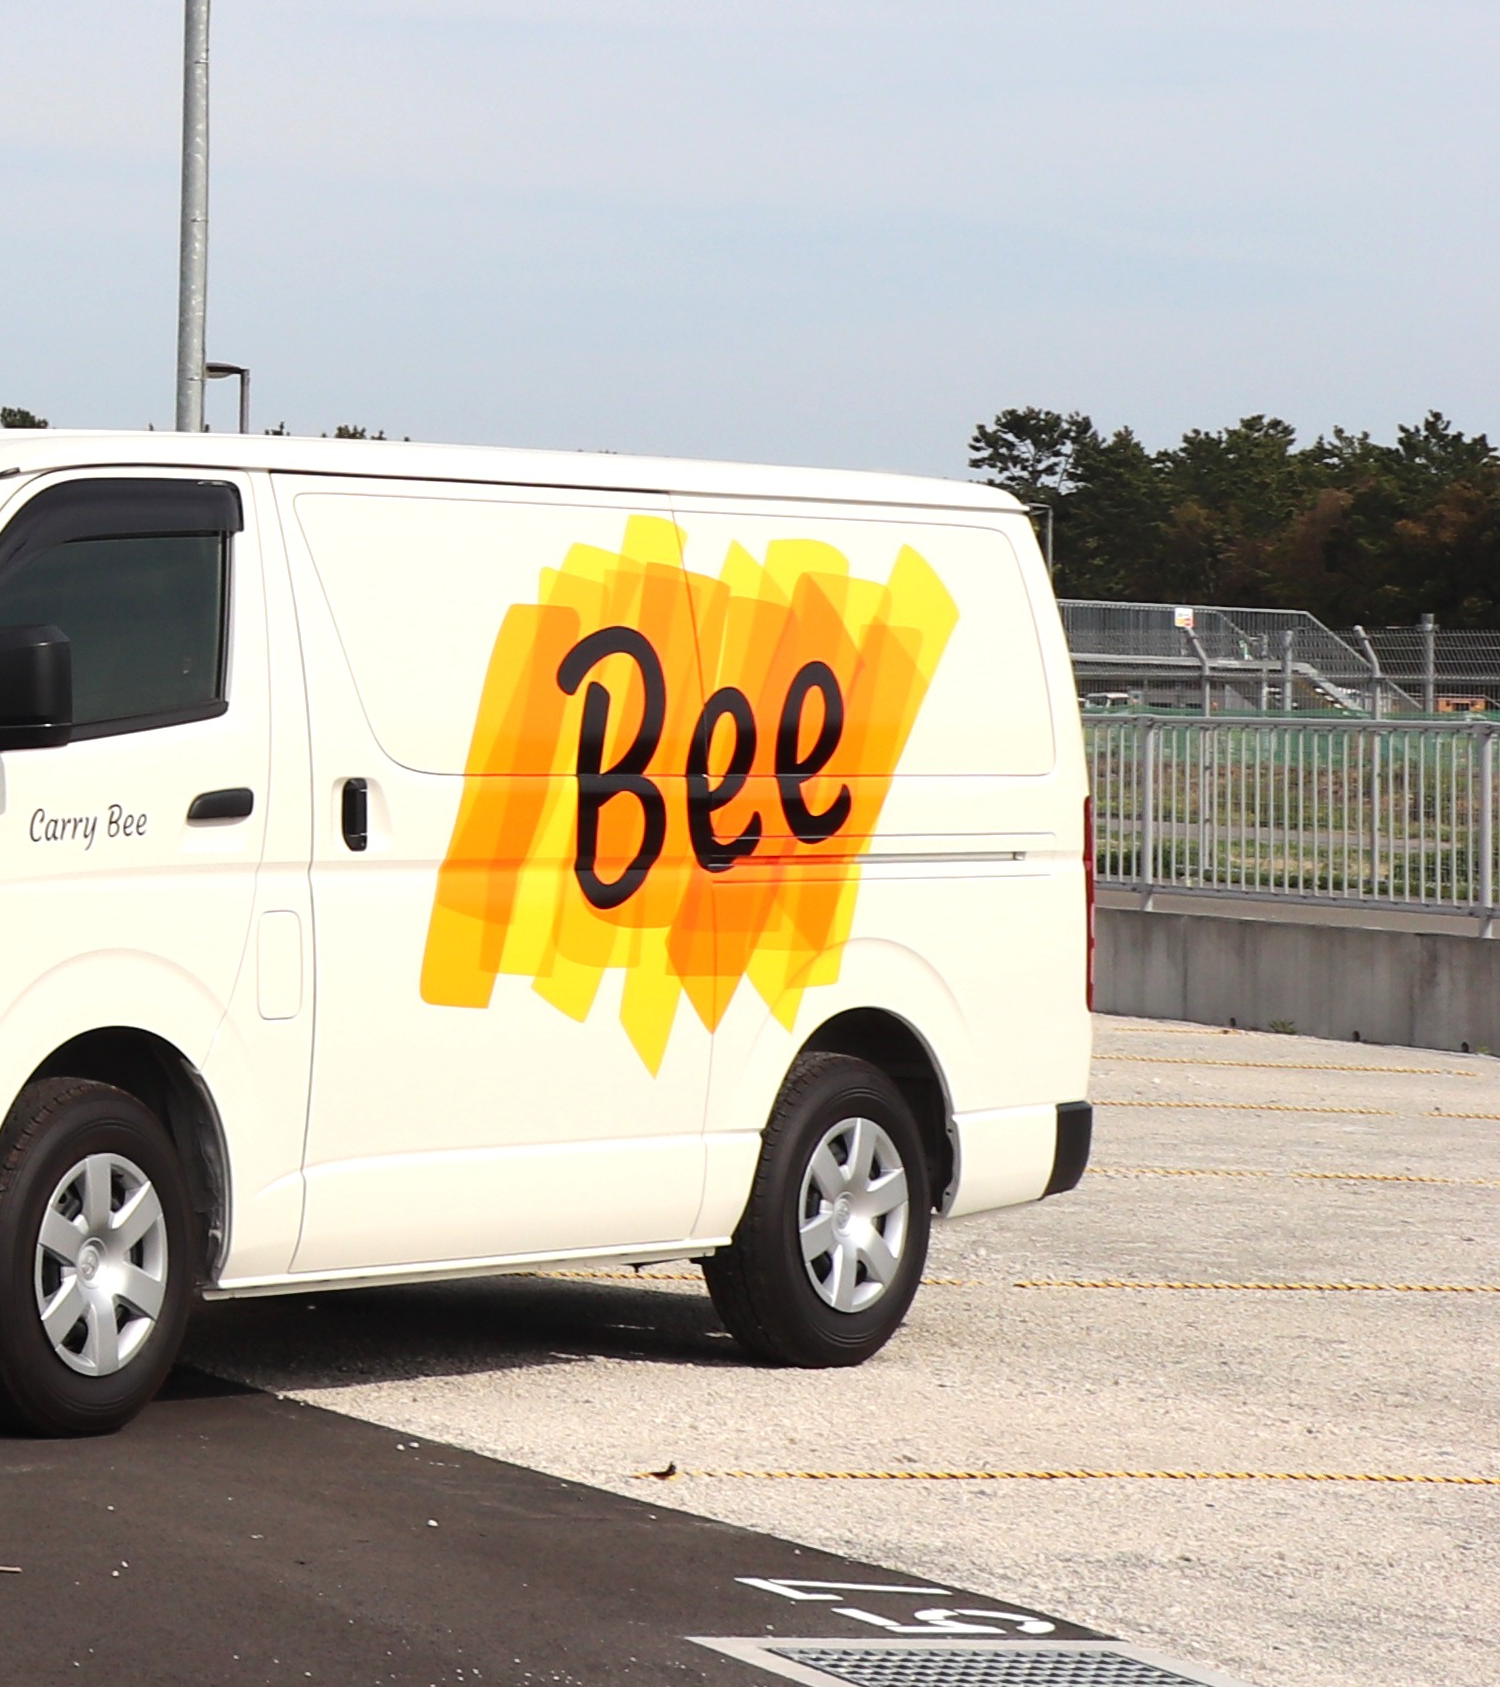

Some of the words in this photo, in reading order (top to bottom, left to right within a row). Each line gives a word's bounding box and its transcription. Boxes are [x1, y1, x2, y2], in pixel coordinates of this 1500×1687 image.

[29, 807, 98, 851] Carry
[107, 803, 148, 838] Bee
[556, 625, 852, 910] Bee
